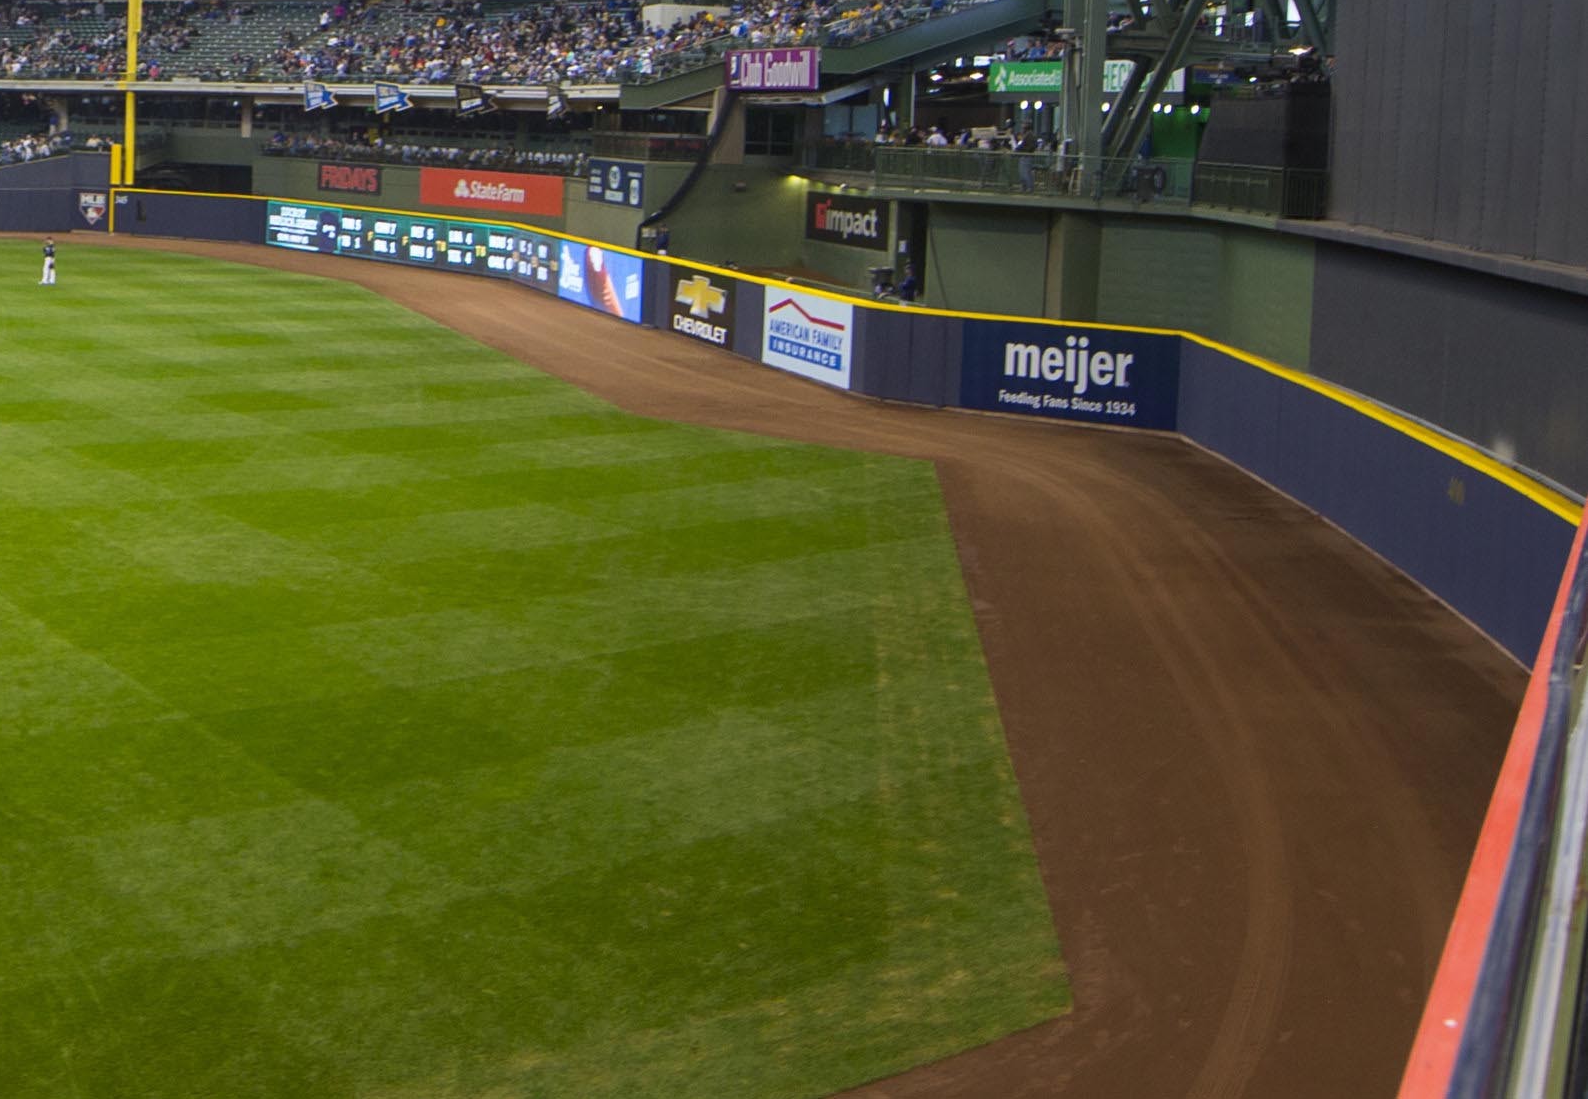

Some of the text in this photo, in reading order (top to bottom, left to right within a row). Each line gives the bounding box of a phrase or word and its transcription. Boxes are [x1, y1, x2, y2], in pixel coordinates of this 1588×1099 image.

[741, 50, 811, 88] Club Goodwill
[321, 165, 378, 192] FRIDAYS
[825, 204, 877, 239] impact
[673, 314, 727, 345] CHEVROLET
[769, 319, 844, 351] AMERICAN FAMILY
[772, 340, 837, 368] INSURANCE
[1004, 335, 1133, 394] meijer
[998, 389, 1137, 418] Feeding Fans Since 1934
